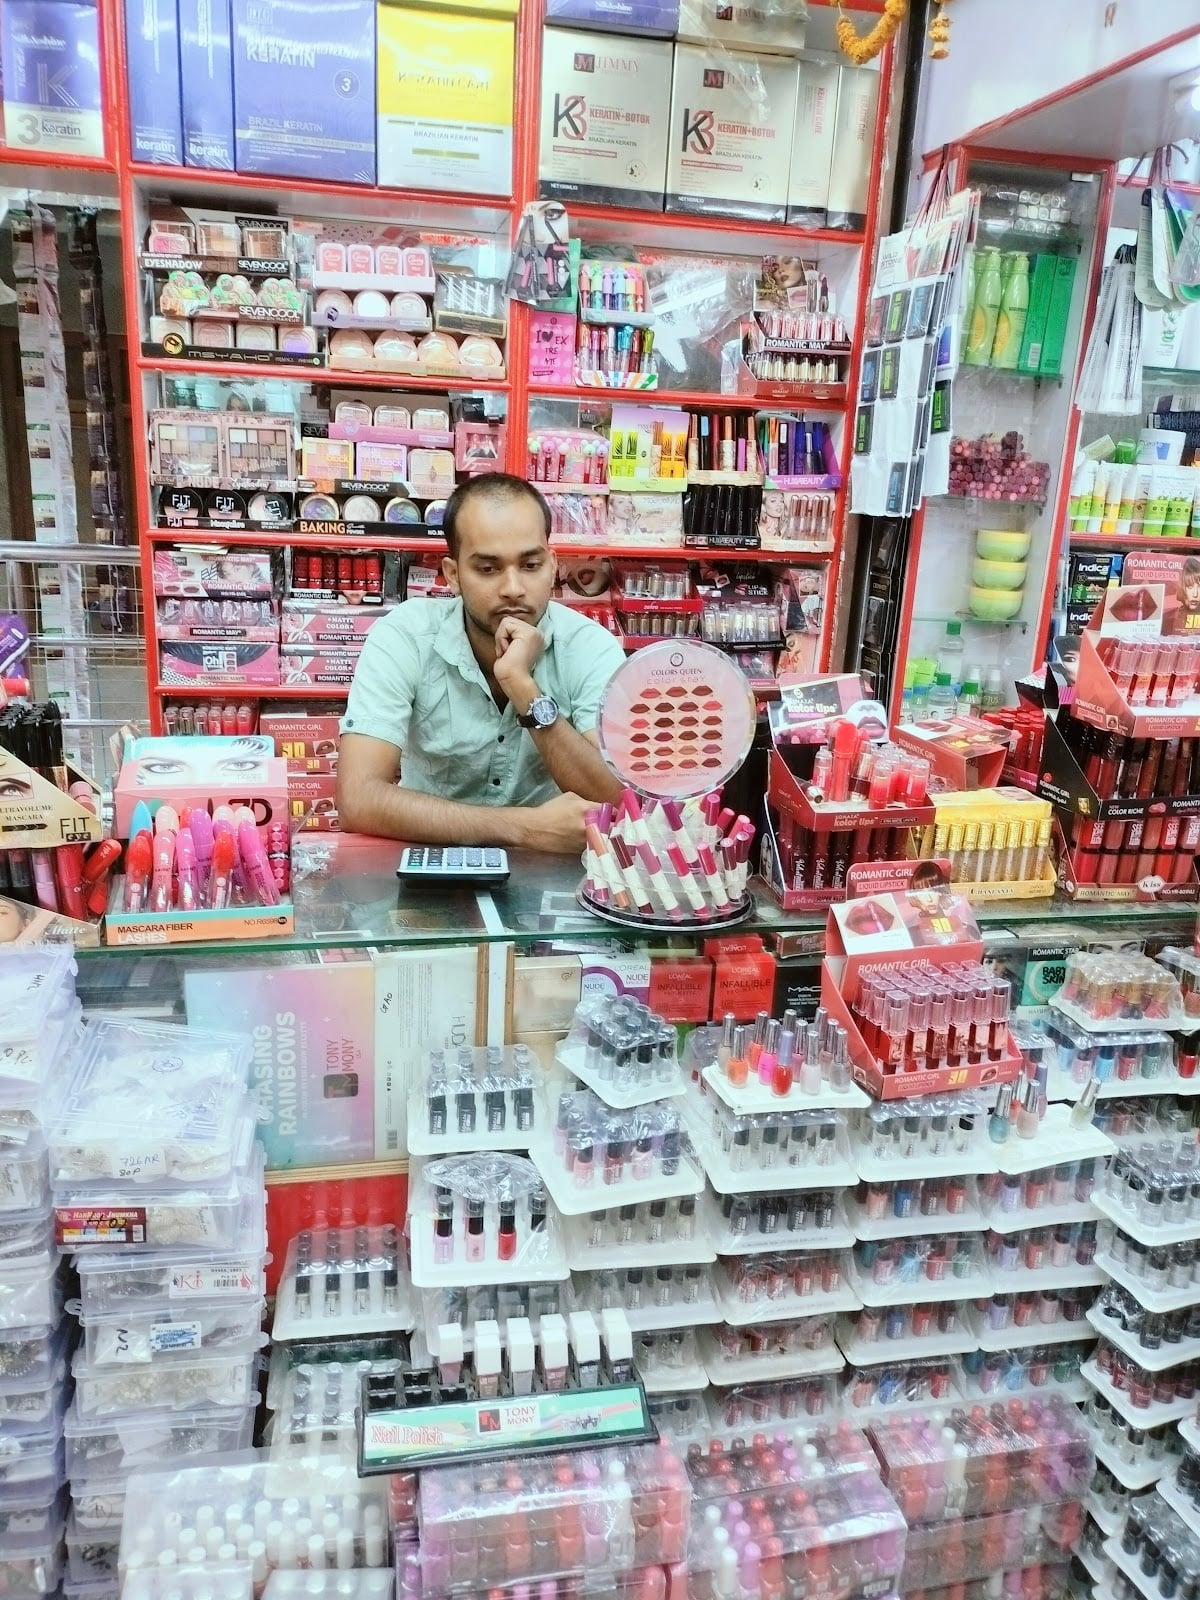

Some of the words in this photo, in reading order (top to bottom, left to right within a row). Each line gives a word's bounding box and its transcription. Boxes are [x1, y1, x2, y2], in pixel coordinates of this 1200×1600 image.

[341, 77, 351, 92] 3
[17, 114, 41, 145] 3
[42, 121, 81, 136] keratin
[248, 116, 282, 129] BRAZIL
[284, 120, 323, 132] KERATIN
[136, 138, 176, 154] keratin
[189, 143, 228, 158] keratin
[144, 259, 202, 270] EYESHADOW
[238, 260, 288, 270] SEVENCOOL
[239, 306, 300, 318] SEVENCOOL
[766, 339, 807, 348] ROMANTIC
[809, 341, 826, 350] MAY
[300, 521, 346, 534] BAKING
[1078, 564, 1110, 573] Indica
[1127, 559, 1167, 568] ROMANTIC
[1168, 561, 1183, 570] GIRL
[1070, 612, 1092, 621] Indic
[0, 805, 53, 814] LTRAVOLUME
[60, 817, 90, 839] FIT
[834, 818, 858, 826] kolor
[859, 818, 874, 827] lips
[851, 870, 894, 880] ROMANTIC
[896, 868, 914, 877] GIRL
[859, 882, 878, 890] LIQUID
[118, 924, 164, 934] MASCARA
[166, 922, 193, 932] FIBER
[118, 932, 167, 944] LASHES
[858, 961, 909, 974] ROMANTIC
[911, 958, 931, 968] GIRL
[1042, 966, 1066, 976] BABY
[720, 978, 772, 990] INFALLIBLE
[1042, 975, 1065, 984] SKIN
[584, 983, 605, 991] NUDE
[658, 983, 702, 992] INFALLIBLE
[326, 1040, 338, 1071] TONY
[341, 1038, 354, 1073] MONY
[276, 1011, 298, 1136] RAINBOWS
[894, 1075, 925, 1084] ROMANTIC
[504, 1406, 536, 1418] TONY
[507, 1416, 534, 1426] MONY
[372, 1425, 400, 1444] Nail
[402, 1424, 444, 1446] Polish
